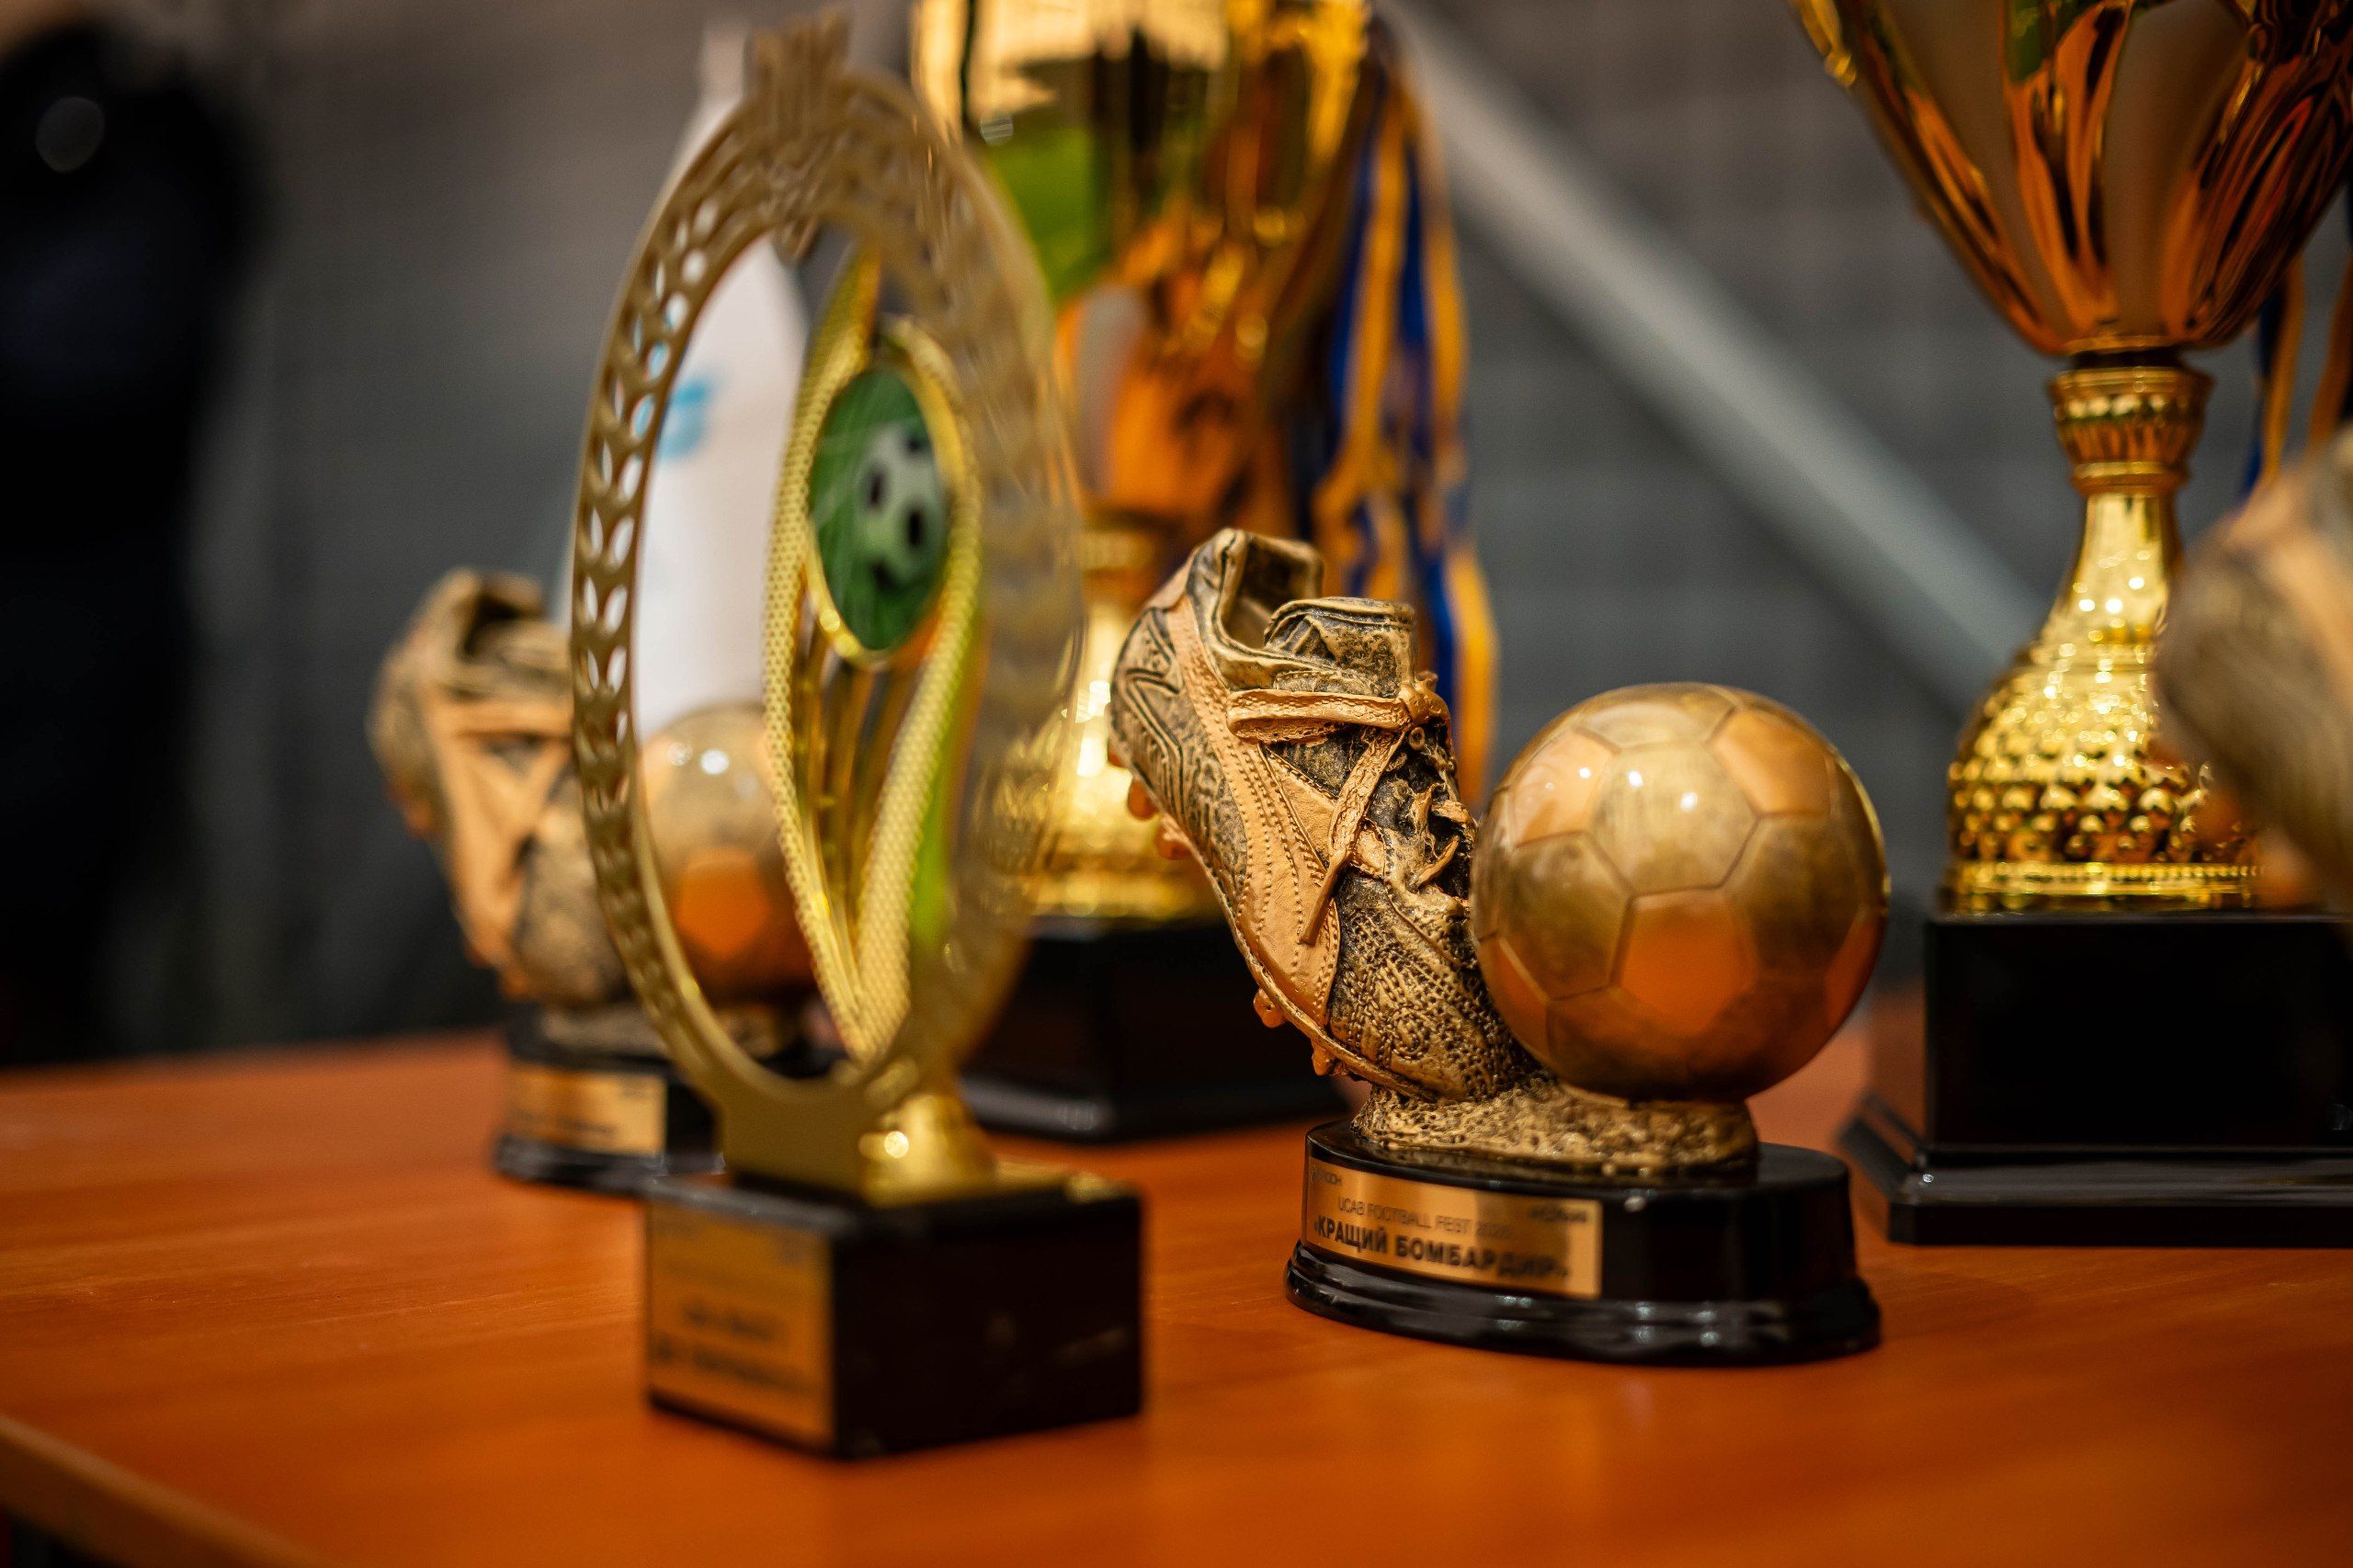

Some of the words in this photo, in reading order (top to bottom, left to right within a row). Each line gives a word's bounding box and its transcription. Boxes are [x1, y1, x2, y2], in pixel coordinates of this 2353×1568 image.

[1338, 1196, 1365, 1216] UCAB
[1368, 1202, 1432, 1229] FOOTBALL
[1436, 1214, 1472, 1234] FEST
